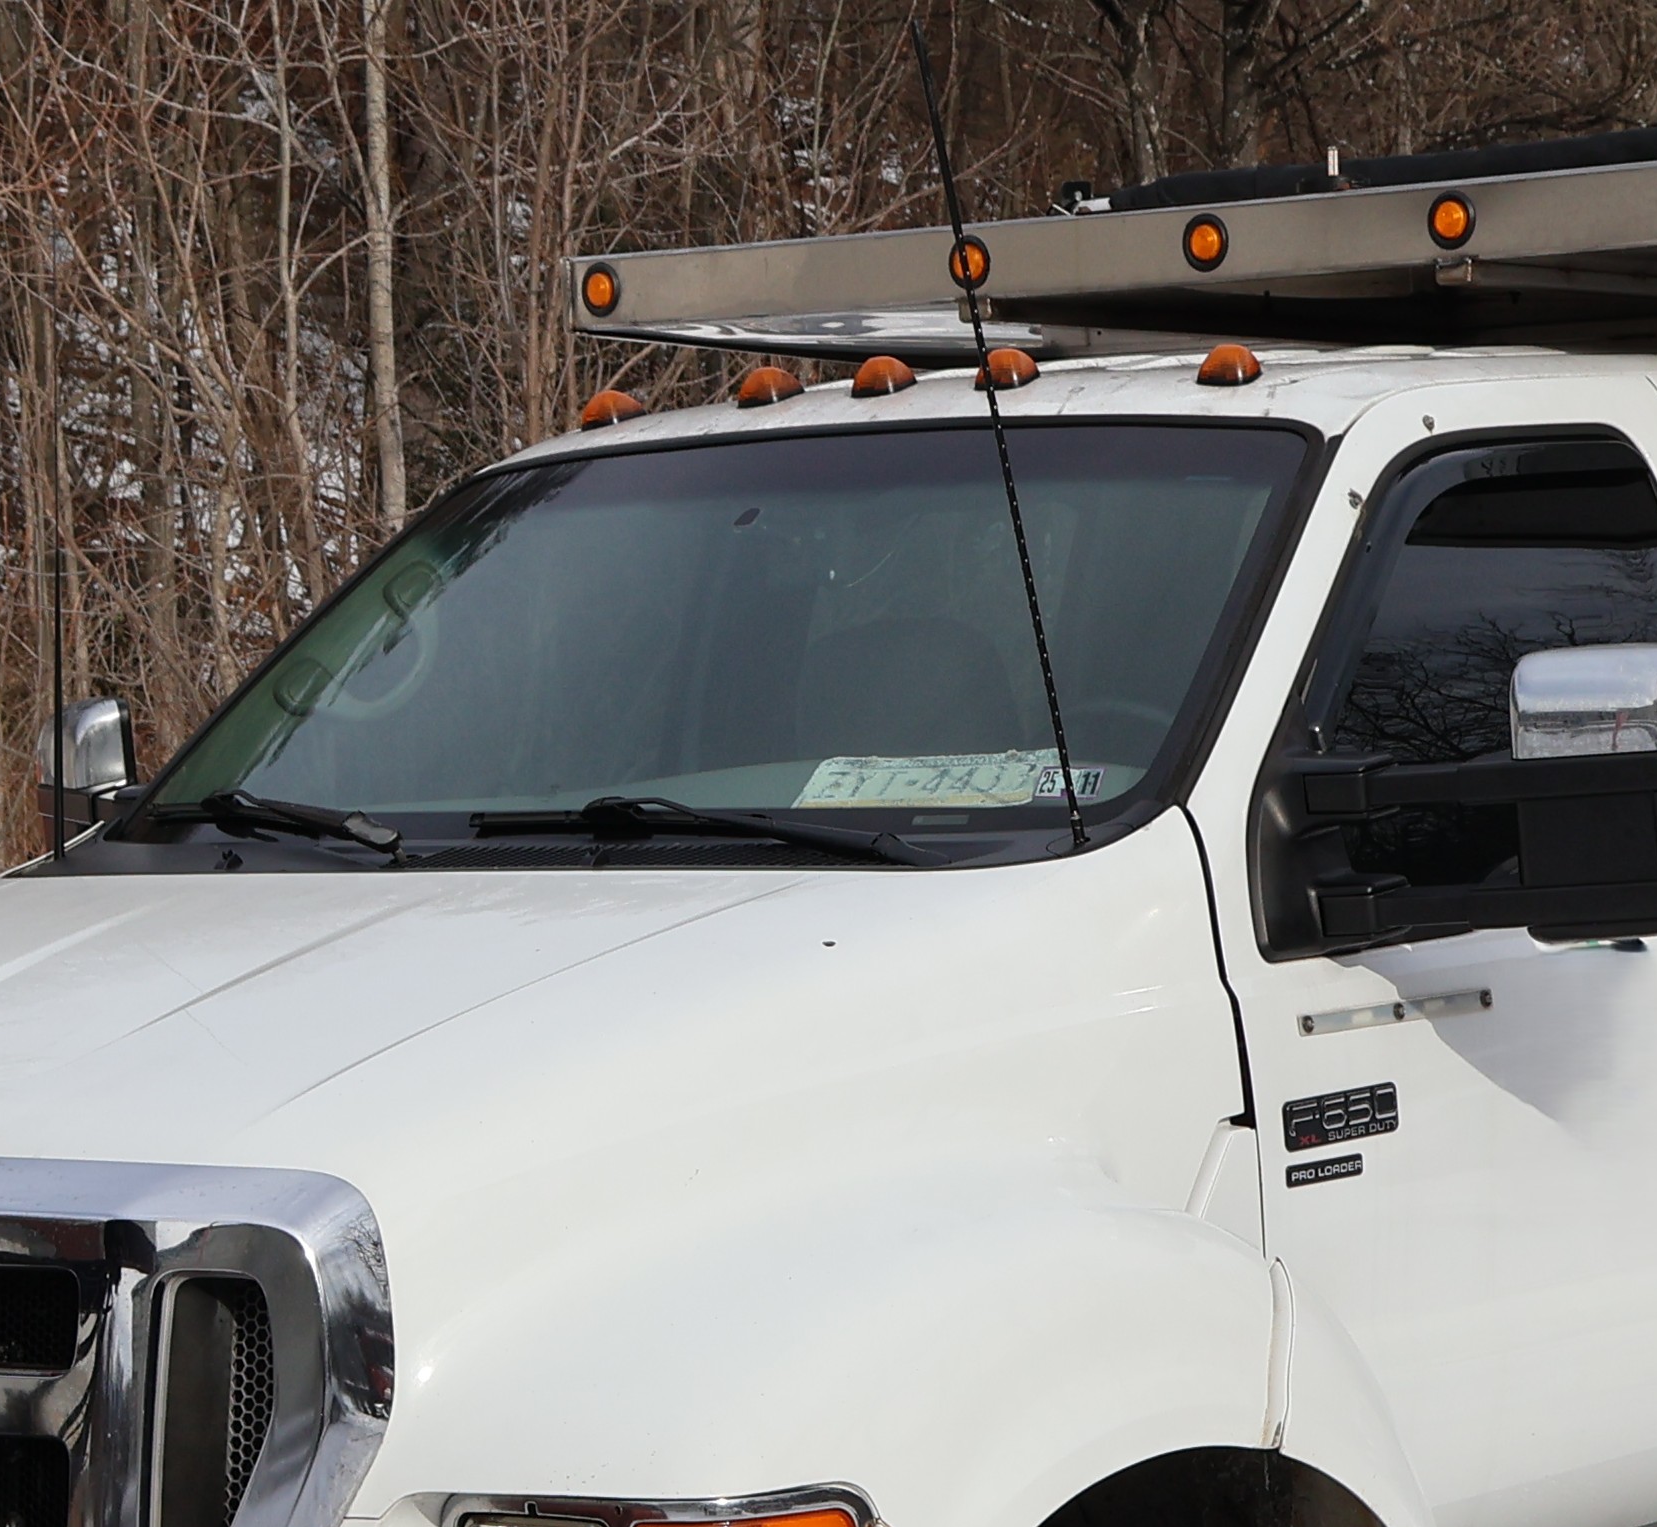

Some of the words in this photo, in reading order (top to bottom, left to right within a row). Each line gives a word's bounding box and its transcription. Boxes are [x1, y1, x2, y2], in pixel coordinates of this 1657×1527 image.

[1039, 770, 1059, 793] 25
[1298, 1134, 1321, 1146] XL
[1328, 1125, 1366, 1141] SUPER
[1369, 1119, 1397, 1133] DUTY
[1291, 1169, 1315, 1182] PRO
[1318, 1160, 1362, 1177] LOADER
